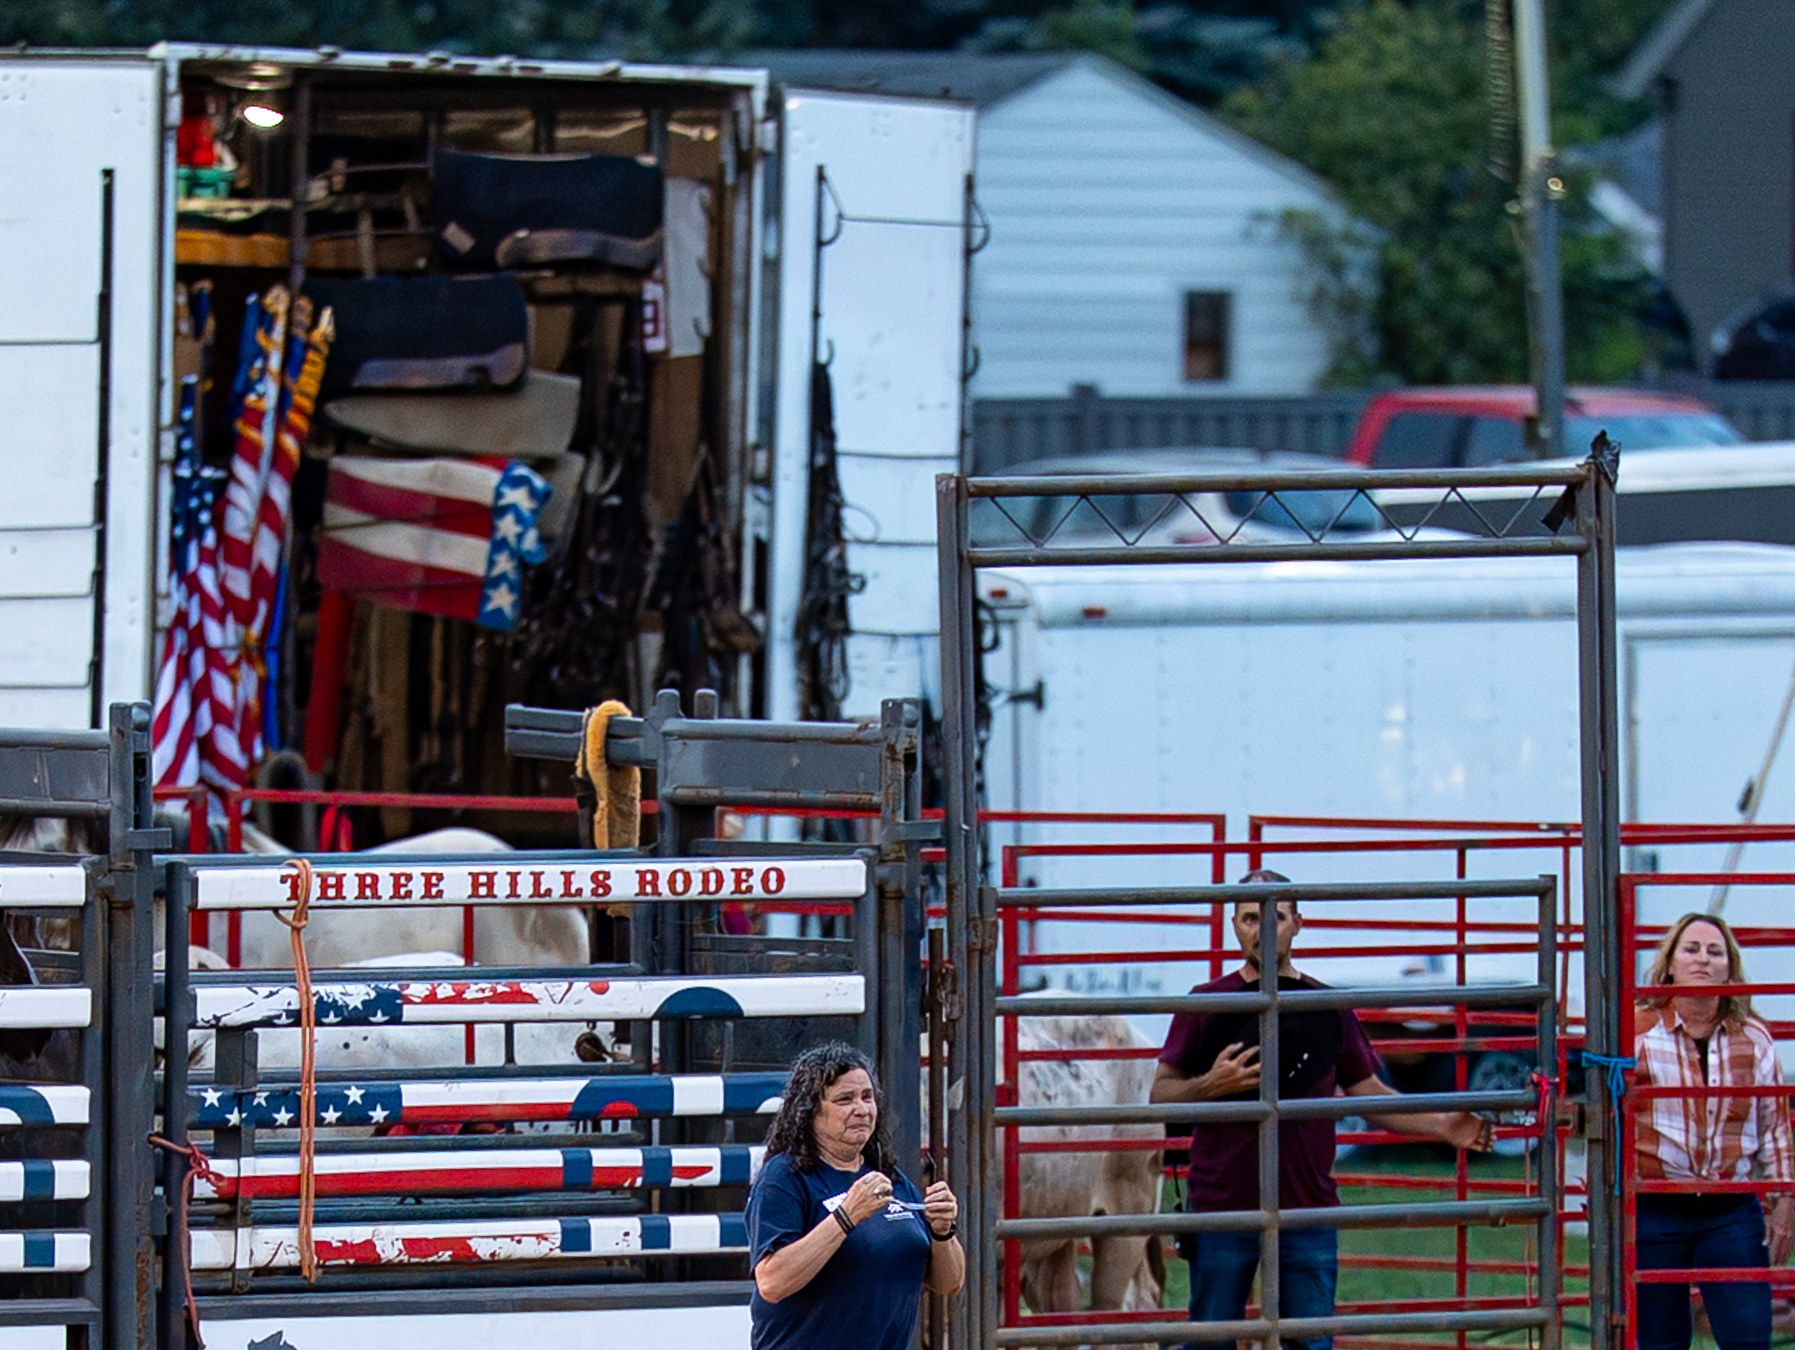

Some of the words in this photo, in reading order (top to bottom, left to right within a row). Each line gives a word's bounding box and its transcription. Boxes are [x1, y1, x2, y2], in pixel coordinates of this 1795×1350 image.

[279, 871, 445, 901] THREE
[467, 870, 613, 899] HILLS
[635, 867, 786, 897] RODEO
